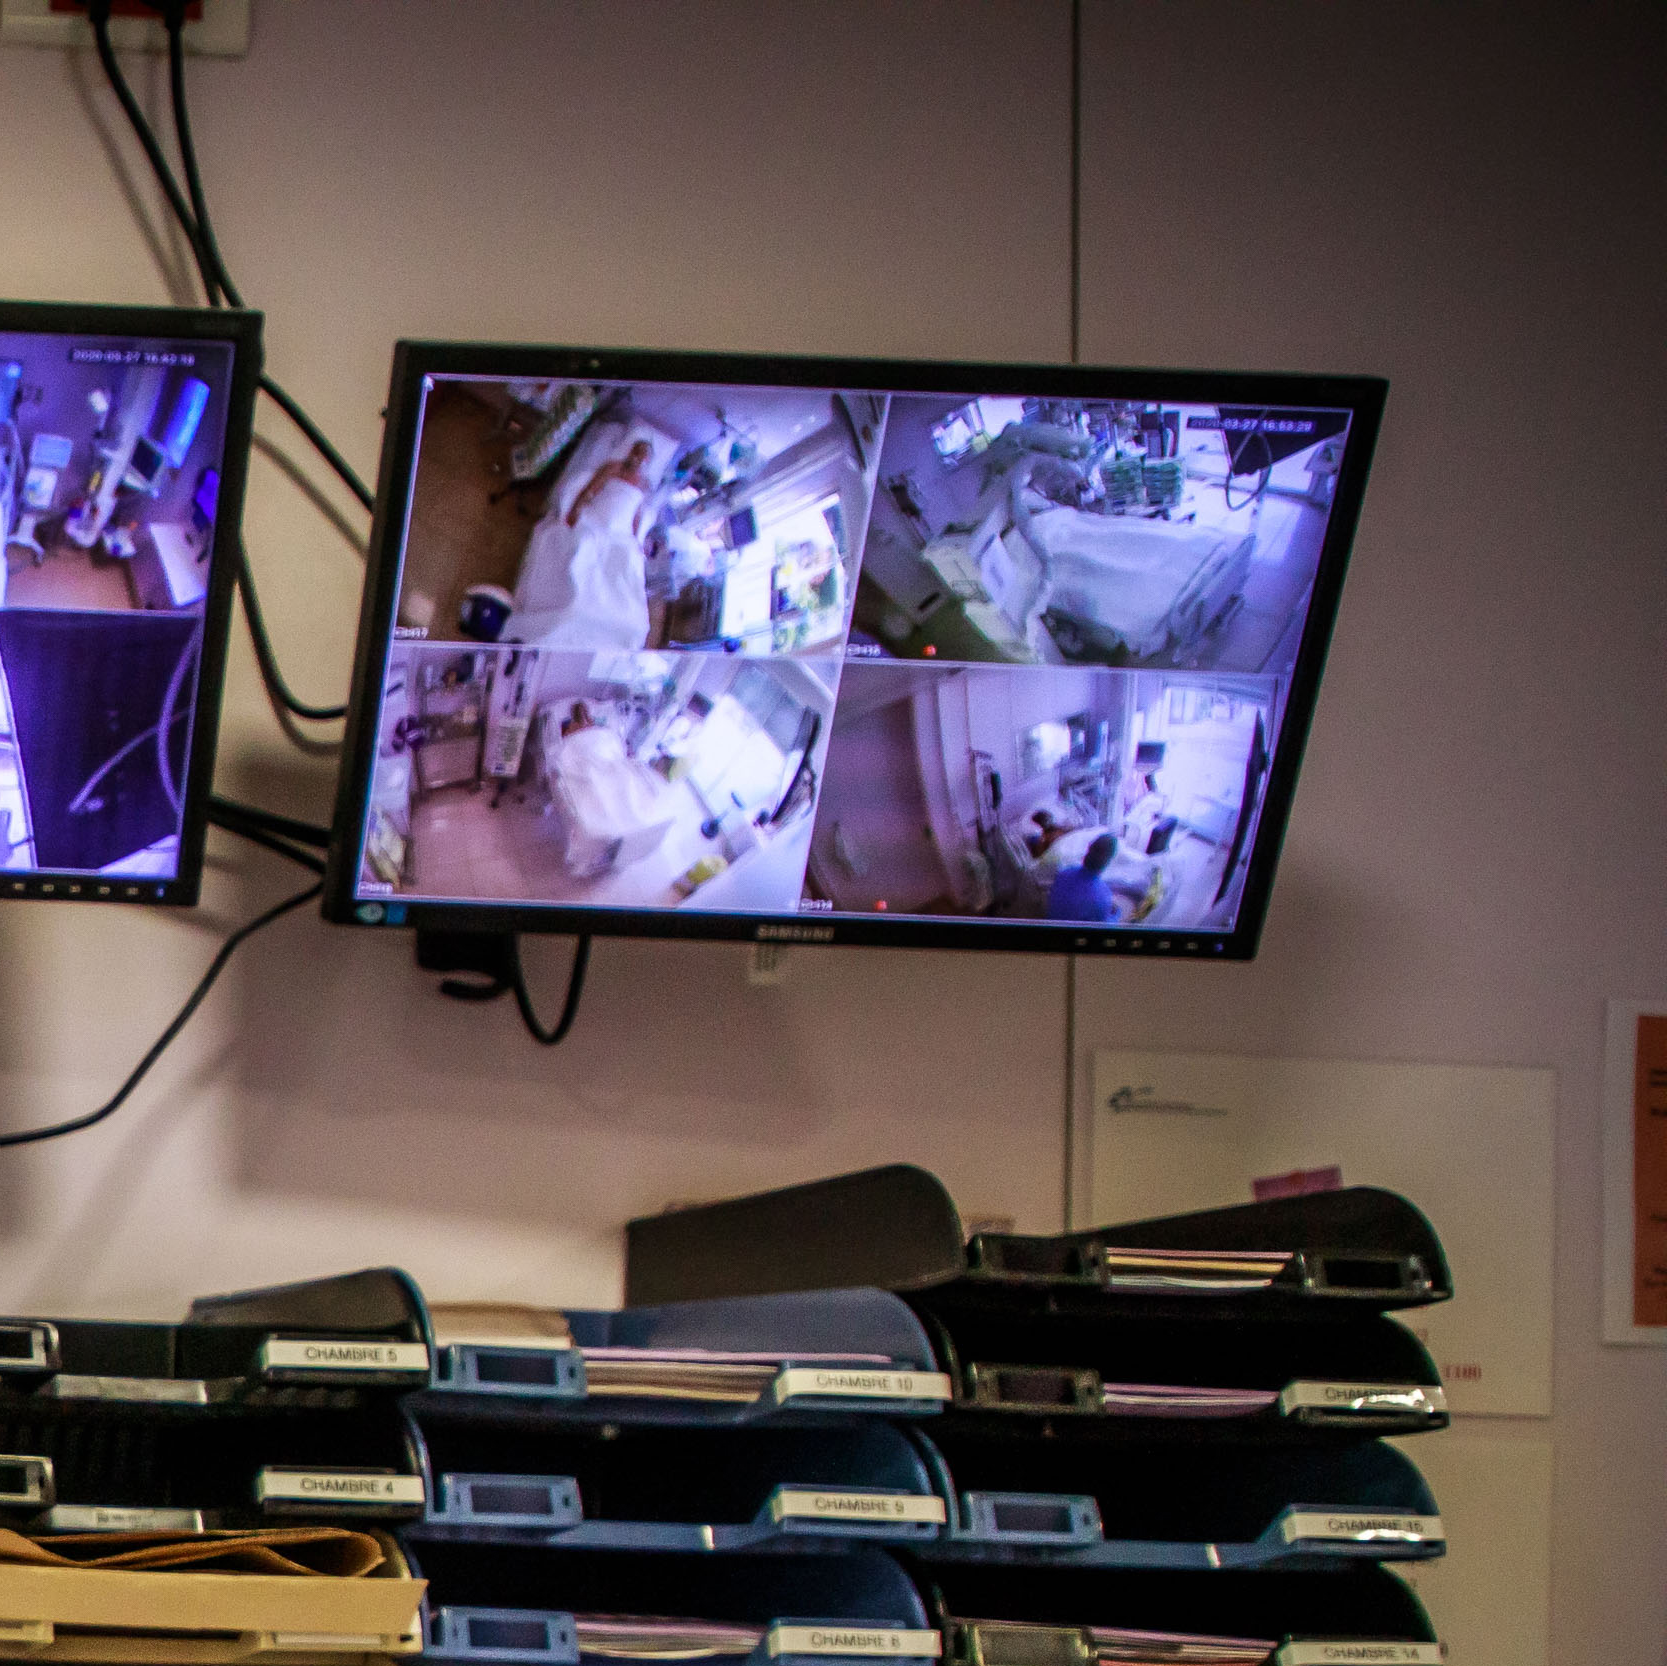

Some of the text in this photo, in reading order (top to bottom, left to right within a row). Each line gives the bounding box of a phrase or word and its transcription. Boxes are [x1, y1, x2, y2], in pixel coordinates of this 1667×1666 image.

[304, 1346, 380, 1362] CHAMBRE
[817, 1374, 890, 1391] CHAMBRE
[301, 1477, 395, 1494] CHAMBRE 4
[815, 1497, 887, 1514] CHAMBRE
[811, 1632, 884, 1649] CHAMBRE
[1324, 1644, 1395, 1661] CHAMBRE
